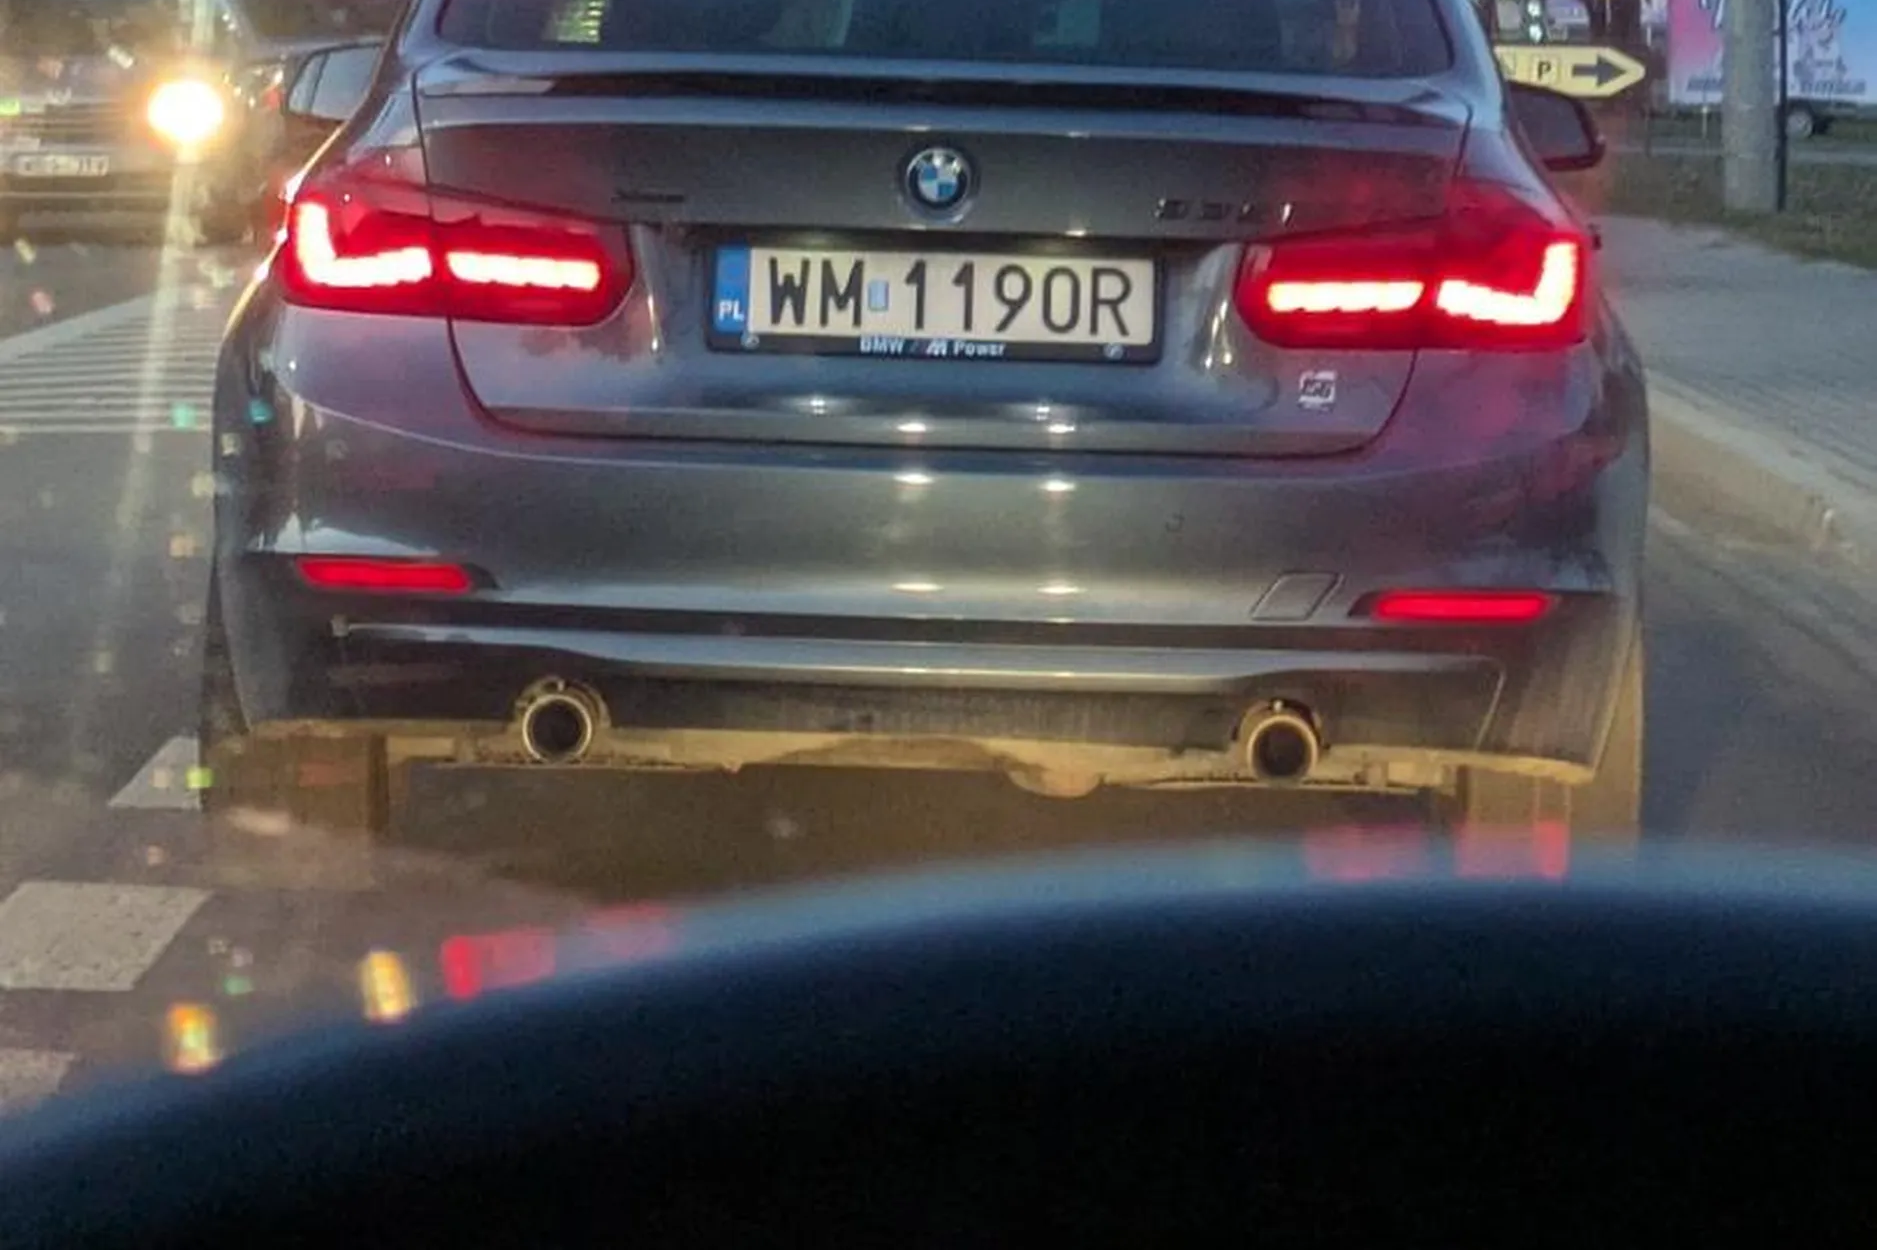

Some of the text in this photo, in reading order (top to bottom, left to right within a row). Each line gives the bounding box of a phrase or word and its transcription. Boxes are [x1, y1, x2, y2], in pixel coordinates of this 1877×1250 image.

[1538, 61, 1551, 81] P
[769, 255, 1132, 337] WM 1190R
[719, 299, 744, 321] PL
[860, 336, 905, 355] BMW
[954, 340, 1006, 357] Power
